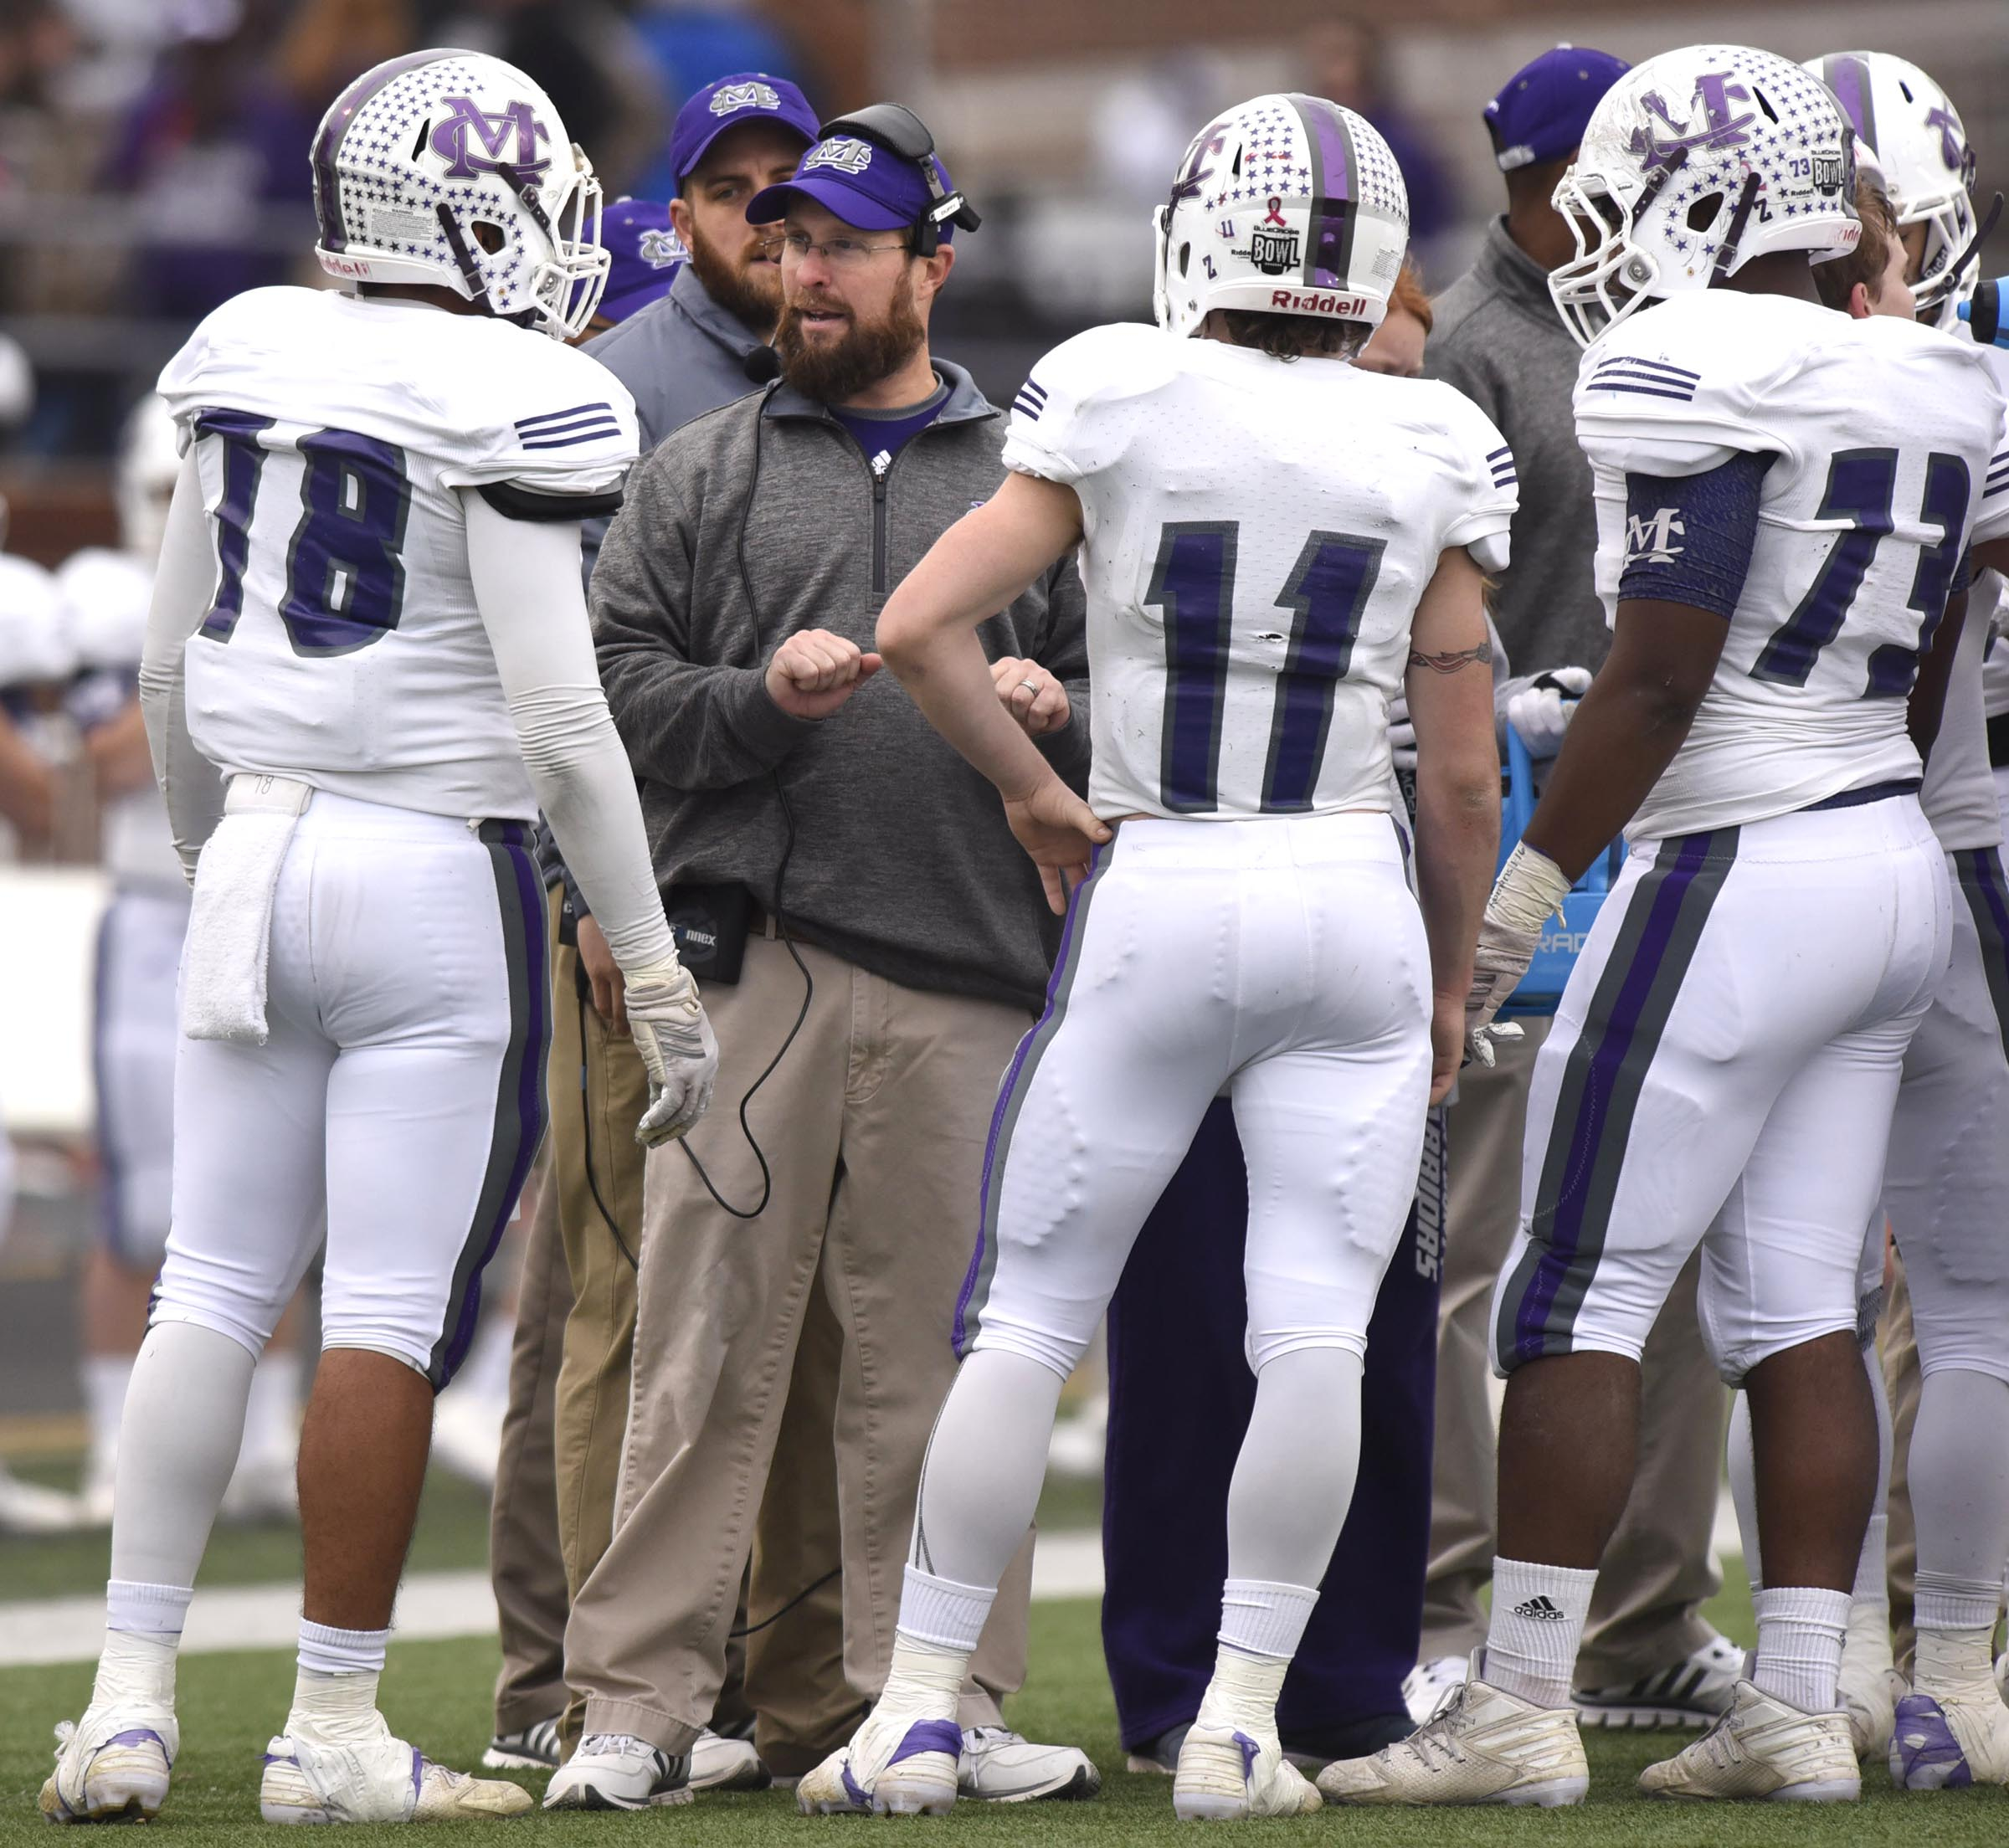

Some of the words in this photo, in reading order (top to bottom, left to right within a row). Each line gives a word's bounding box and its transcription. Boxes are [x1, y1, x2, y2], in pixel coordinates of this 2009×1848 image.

[1789, 157, 1811, 178] 73
[1815, 160, 1844, 185] BOWL
[1221, 219, 1235, 239] 11
[1253, 235, 1298, 265] BOWL
[1272, 290, 1367, 316] Riddell
[1749, 447, 1971, 698] 73
[1143, 521, 1388, 814] 11
[1513, 1606, 1565, 1620] adidas
